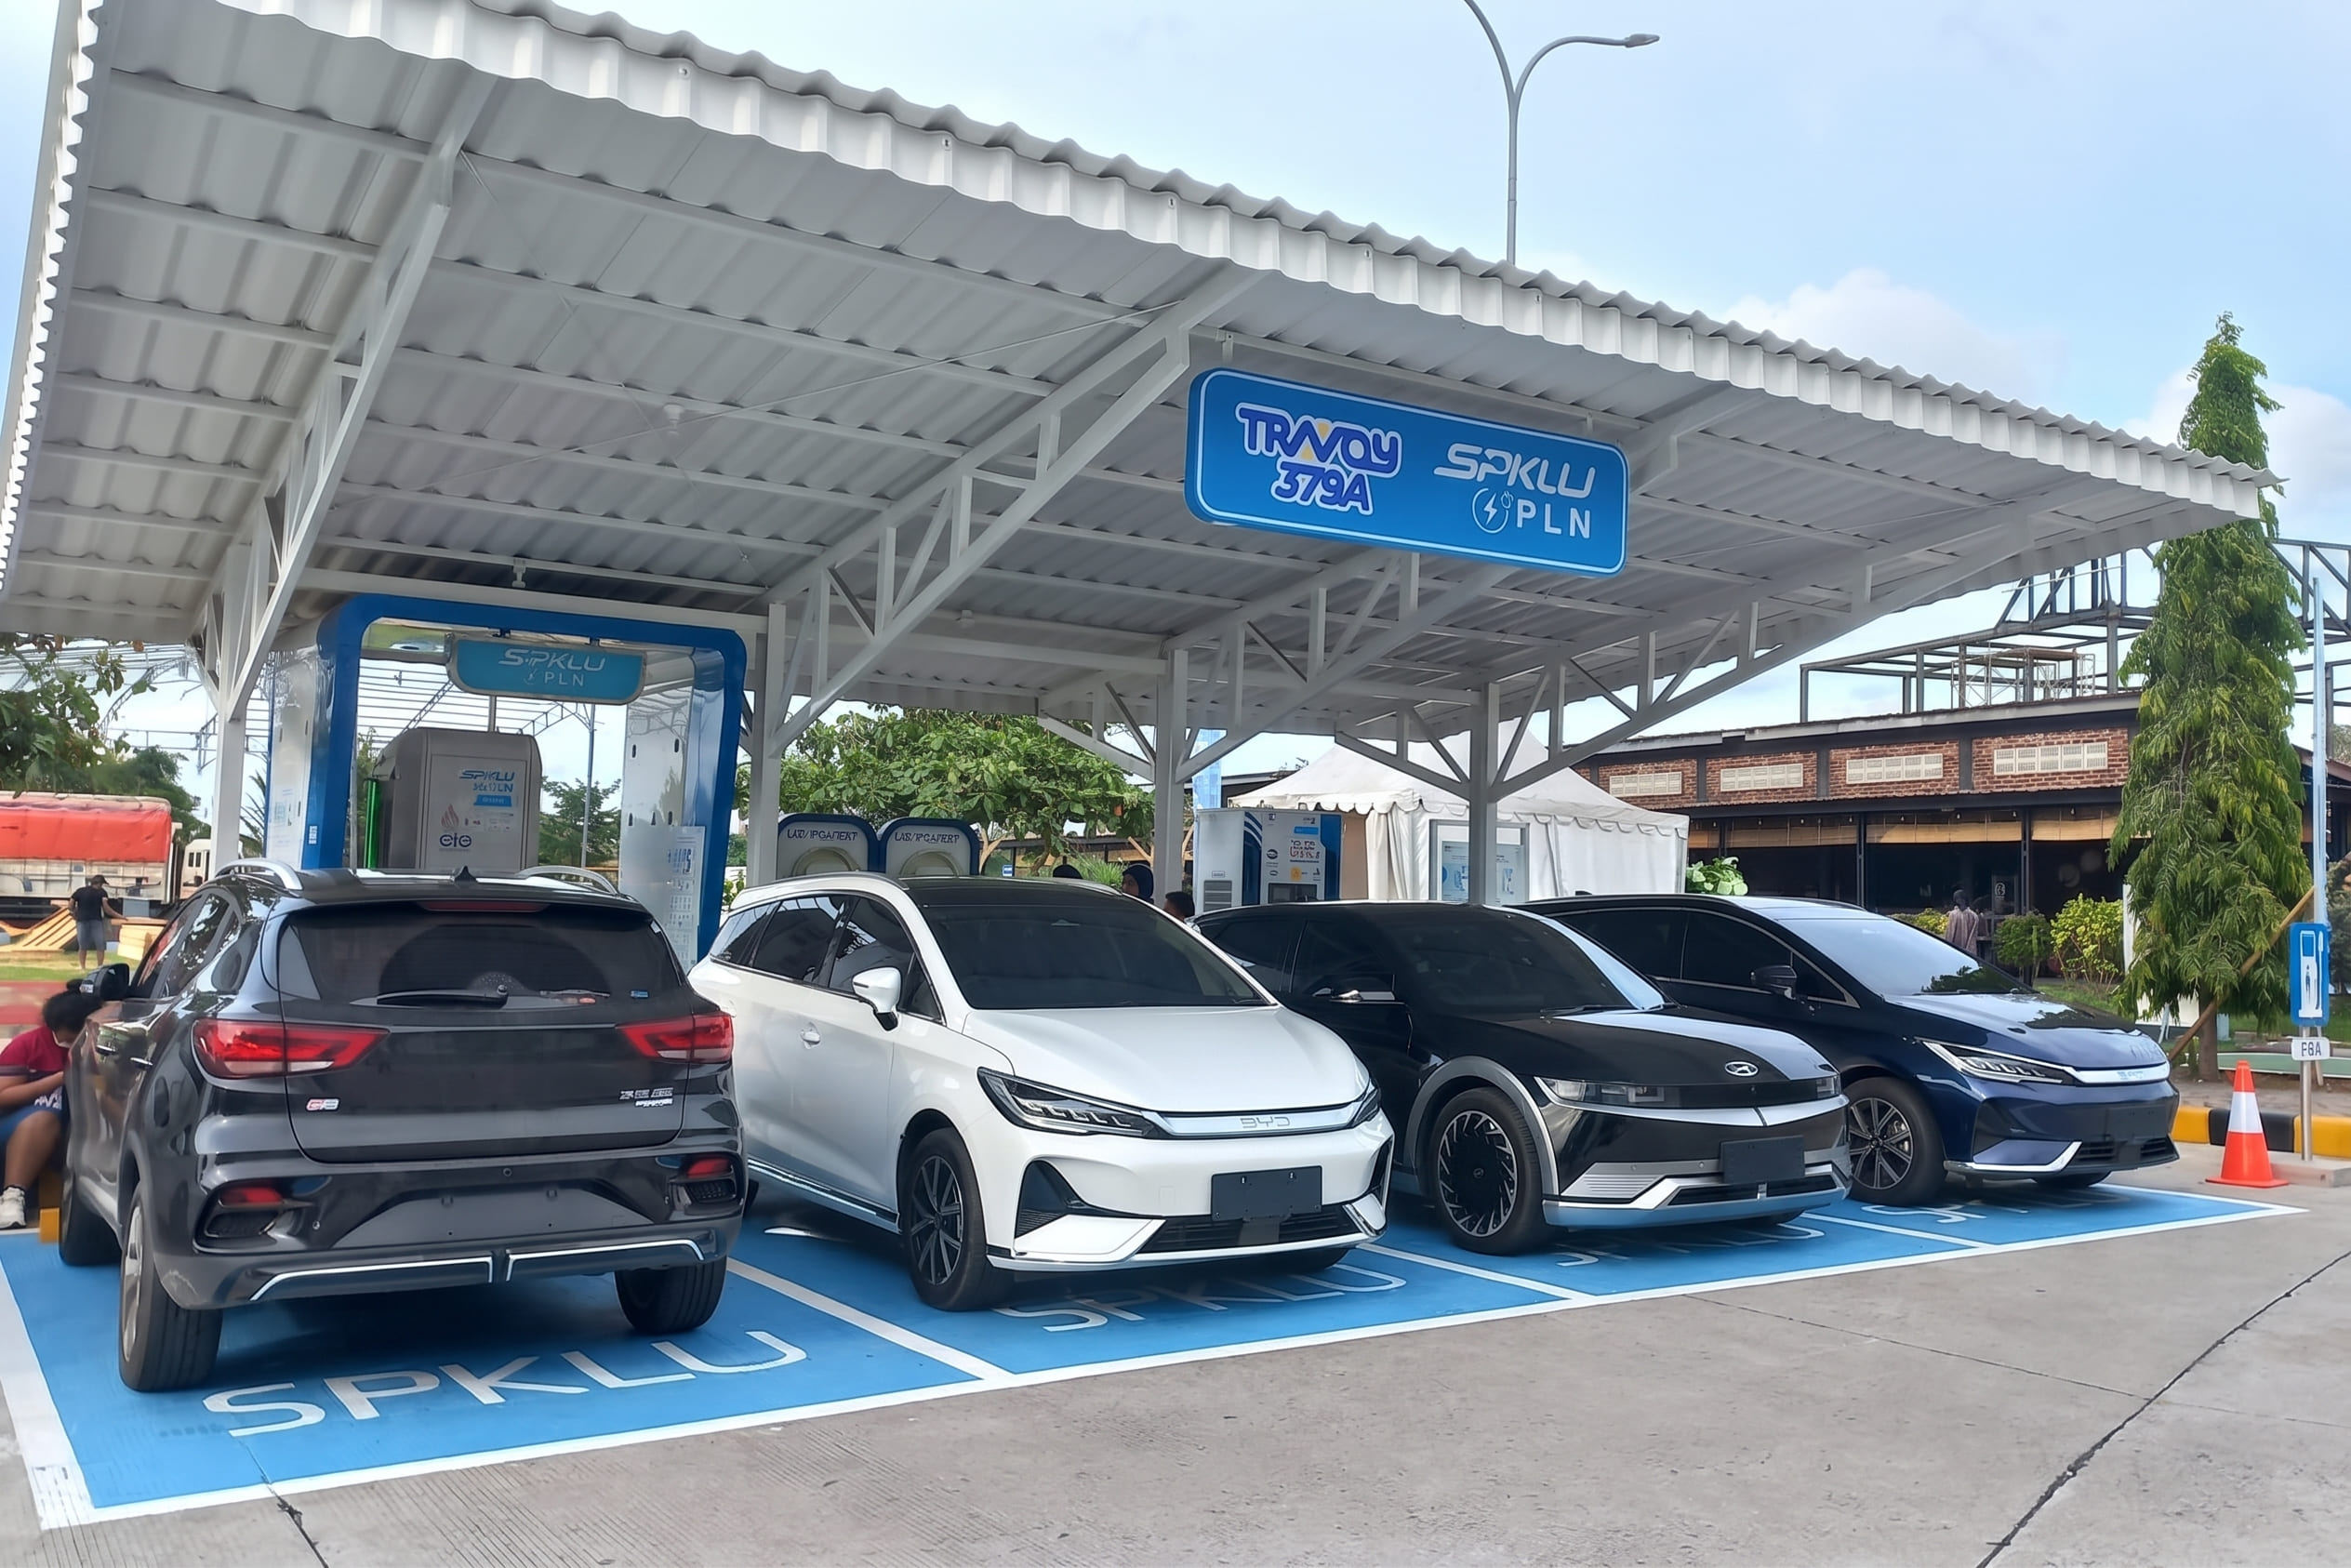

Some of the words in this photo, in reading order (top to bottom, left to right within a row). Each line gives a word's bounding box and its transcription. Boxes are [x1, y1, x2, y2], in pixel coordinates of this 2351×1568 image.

[1237, 404, 1401, 475] TRAVOY
[1273, 460, 1372, 513] 379A
[1434, 443, 1595, 498] SPKLU
[1517, 498, 1591, 538] PLN
[498, 648, 605, 671] SPKLU
[544, 671, 584, 687] PLN
[1240, 1116, 1290, 1128] BYD
[202, 1331, 807, 1438] SPKLU
